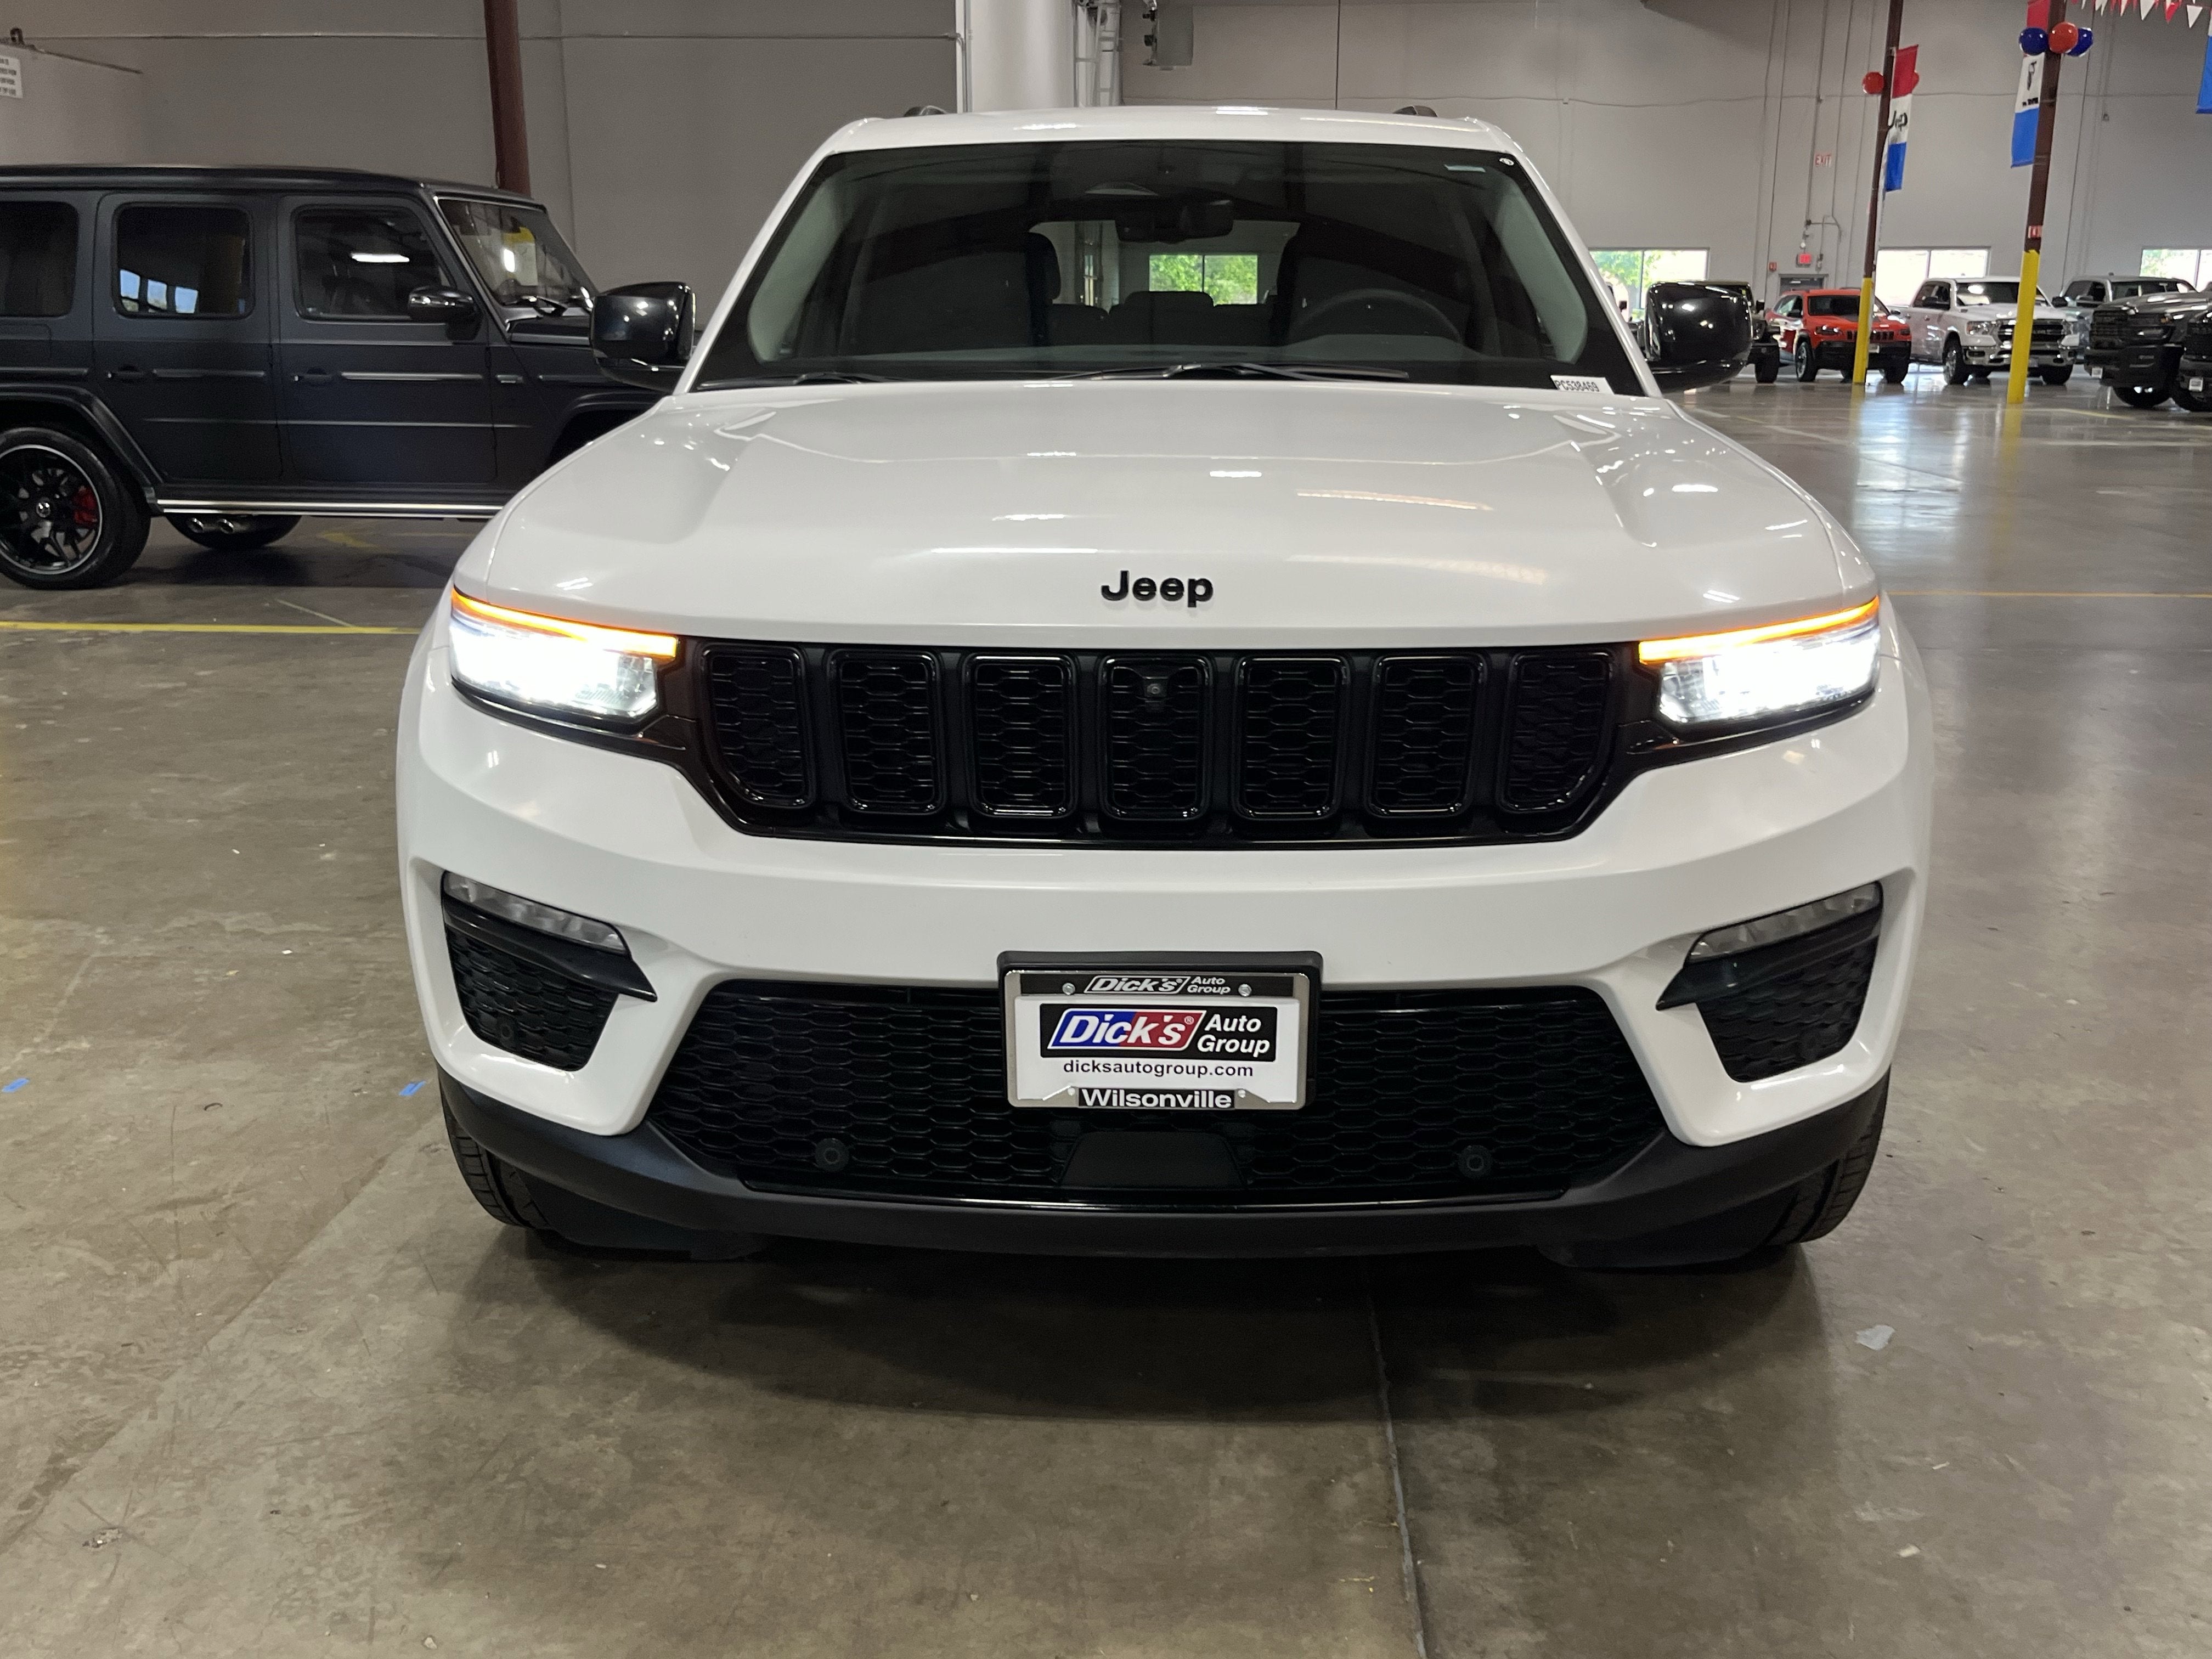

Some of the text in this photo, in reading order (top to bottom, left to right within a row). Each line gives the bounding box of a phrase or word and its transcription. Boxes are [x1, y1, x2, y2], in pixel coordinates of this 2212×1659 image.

[1101, 570, 1214, 608] Jeep
[1091, 976, 1226, 992] Dick's Auto
[1187, 984, 1231, 995] Group
[1059, 1014, 1262, 1045] Dick's Auto
[1197, 1034, 1271, 1058] Group
[1063, 1060, 1253, 1078] dicksautogroup.com
[1081, 1088, 1232, 1108] Wilsonville
